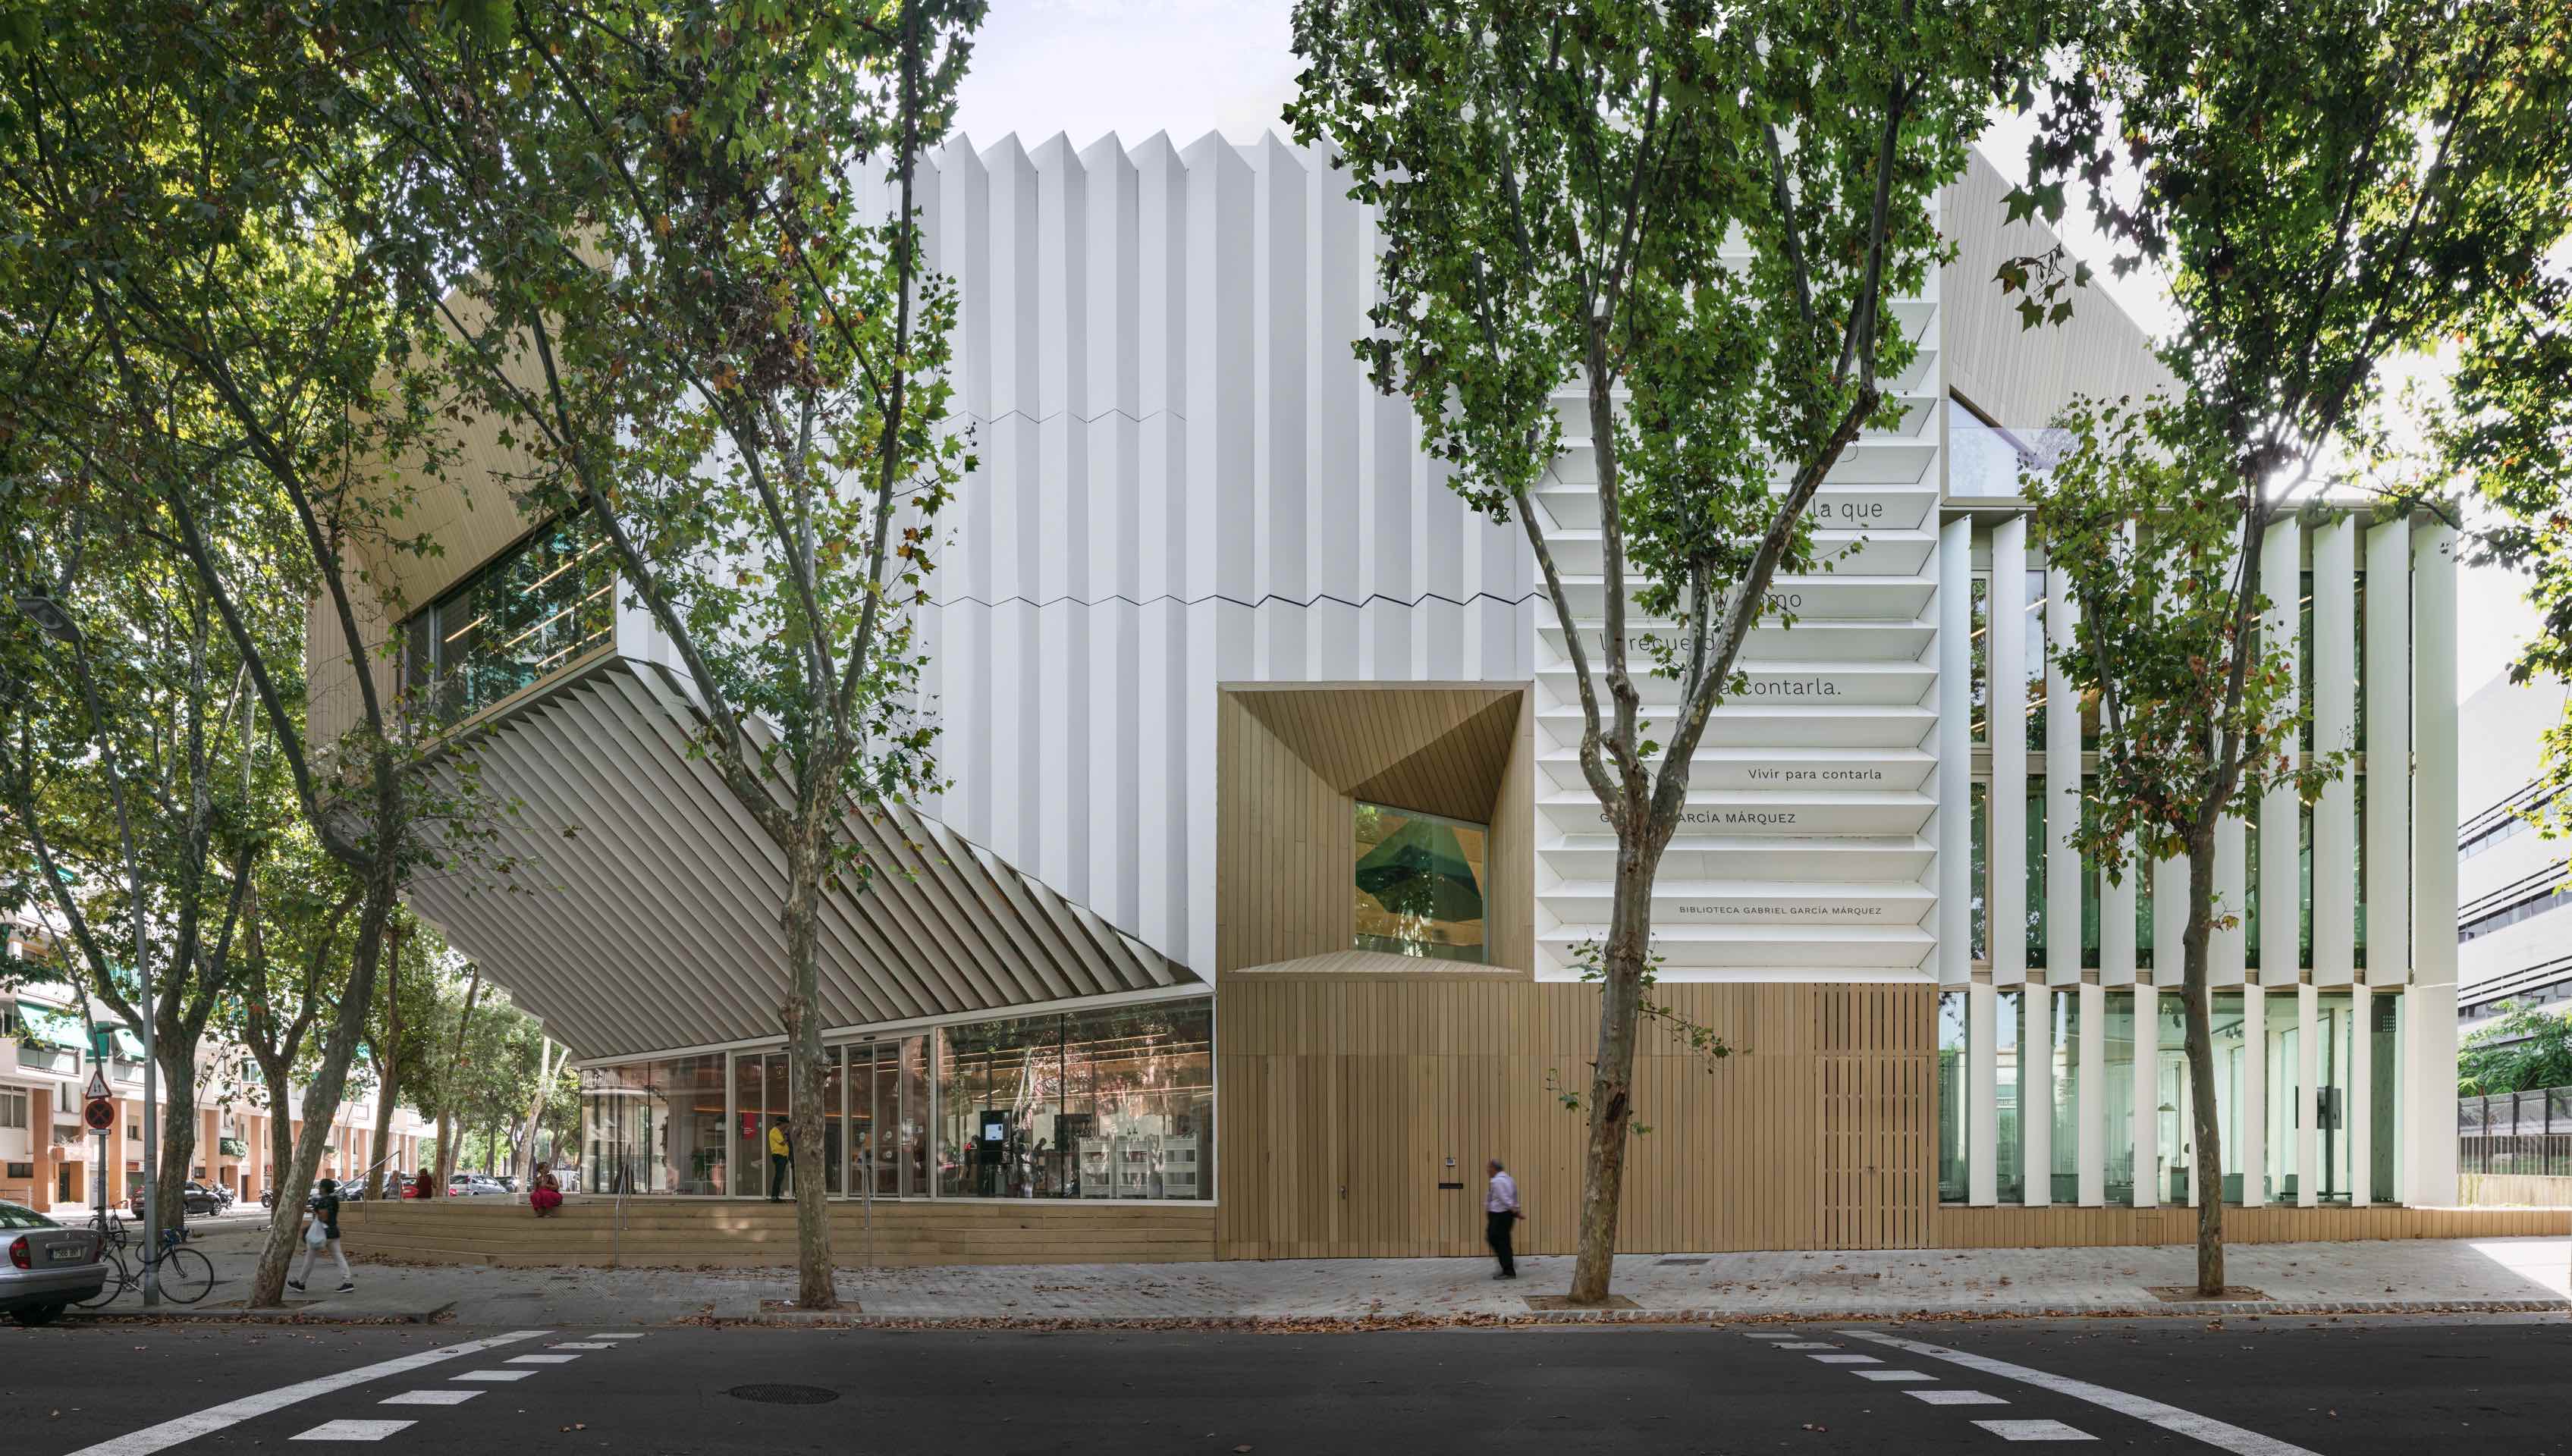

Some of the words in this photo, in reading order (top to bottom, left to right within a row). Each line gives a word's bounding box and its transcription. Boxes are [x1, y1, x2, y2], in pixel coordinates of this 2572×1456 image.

[1842, 504, 1883, 522] que
[1748, 769, 1780, 779] Vivir
[1785, 771, 1817, 781] para
[1822, 769, 1882, 780] contarla
[1676, 811, 1720, 824] ARCÍA
[1726, 811, 1796, 825] MÁRQUEZ
[1790, 906, 1827, 915] GARCÍA
[1832, 905, 1882, 915] MÁRQUEZ
